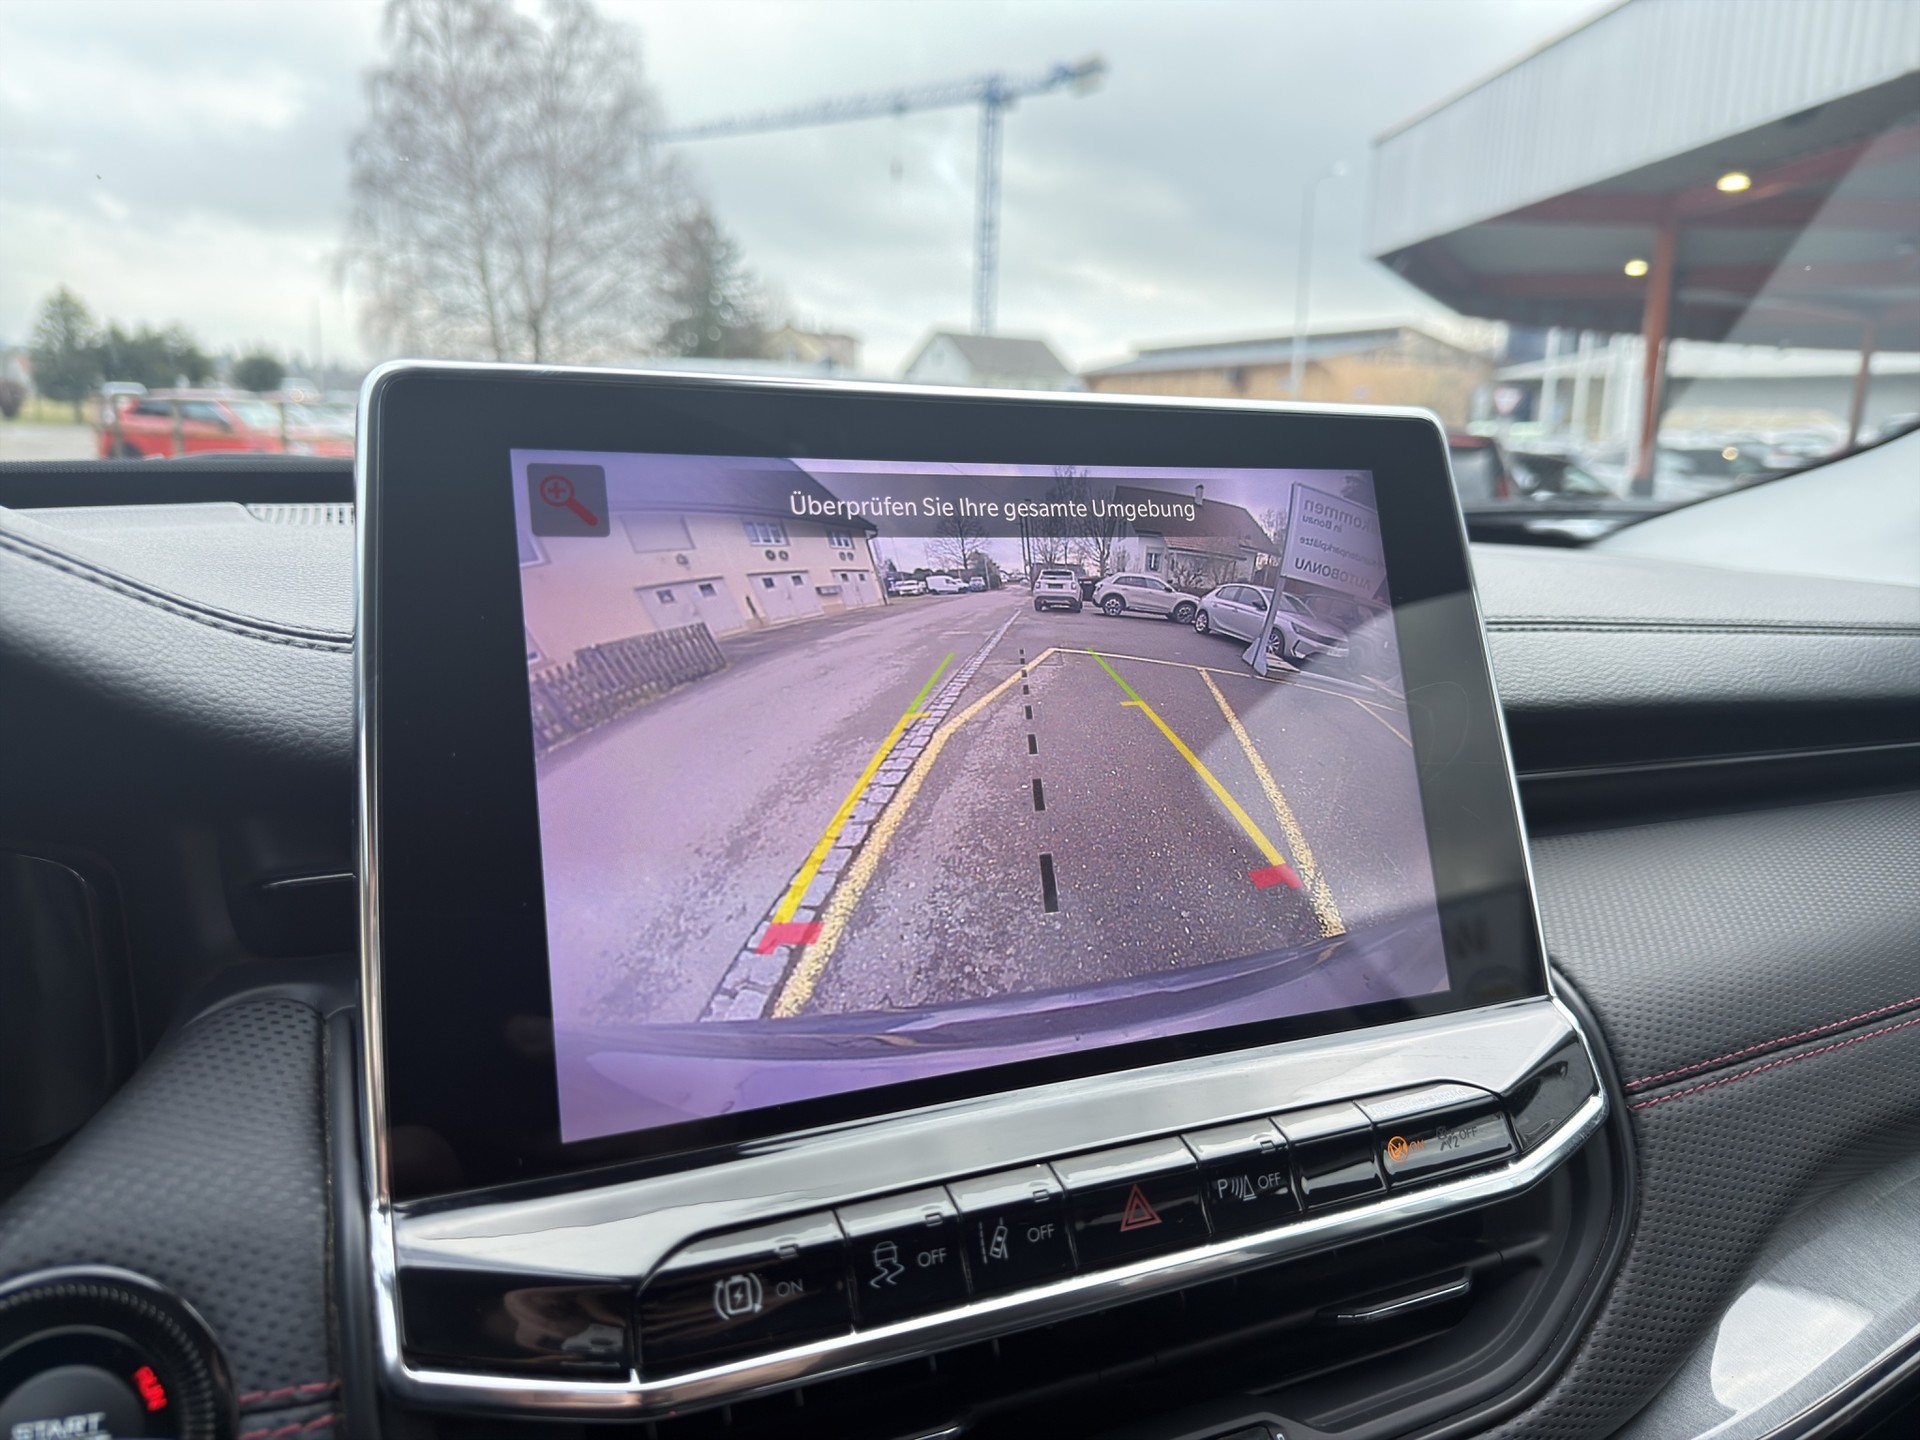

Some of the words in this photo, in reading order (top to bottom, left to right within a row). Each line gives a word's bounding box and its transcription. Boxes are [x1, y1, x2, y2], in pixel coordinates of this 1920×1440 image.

[790, 491, 917, 520] Überprüfen
[922, 497, 954, 517] Sie
[959, 497, 999, 518] Ihre
[1004, 499, 1088, 522] gesamte
[1092, 499, 1196, 522] Umgebung
[1459, 1126, 1478, 1140] OFF
[1409, 1139, 1425, 1151] ON
[1257, 1172, 1282, 1190] OFF
[1027, 1223, 1056, 1243] OFF
[917, 1248, 948, 1268] OFF
[777, 1280, 804, 1298] ON
[11, 1411, 106, 1440] START
